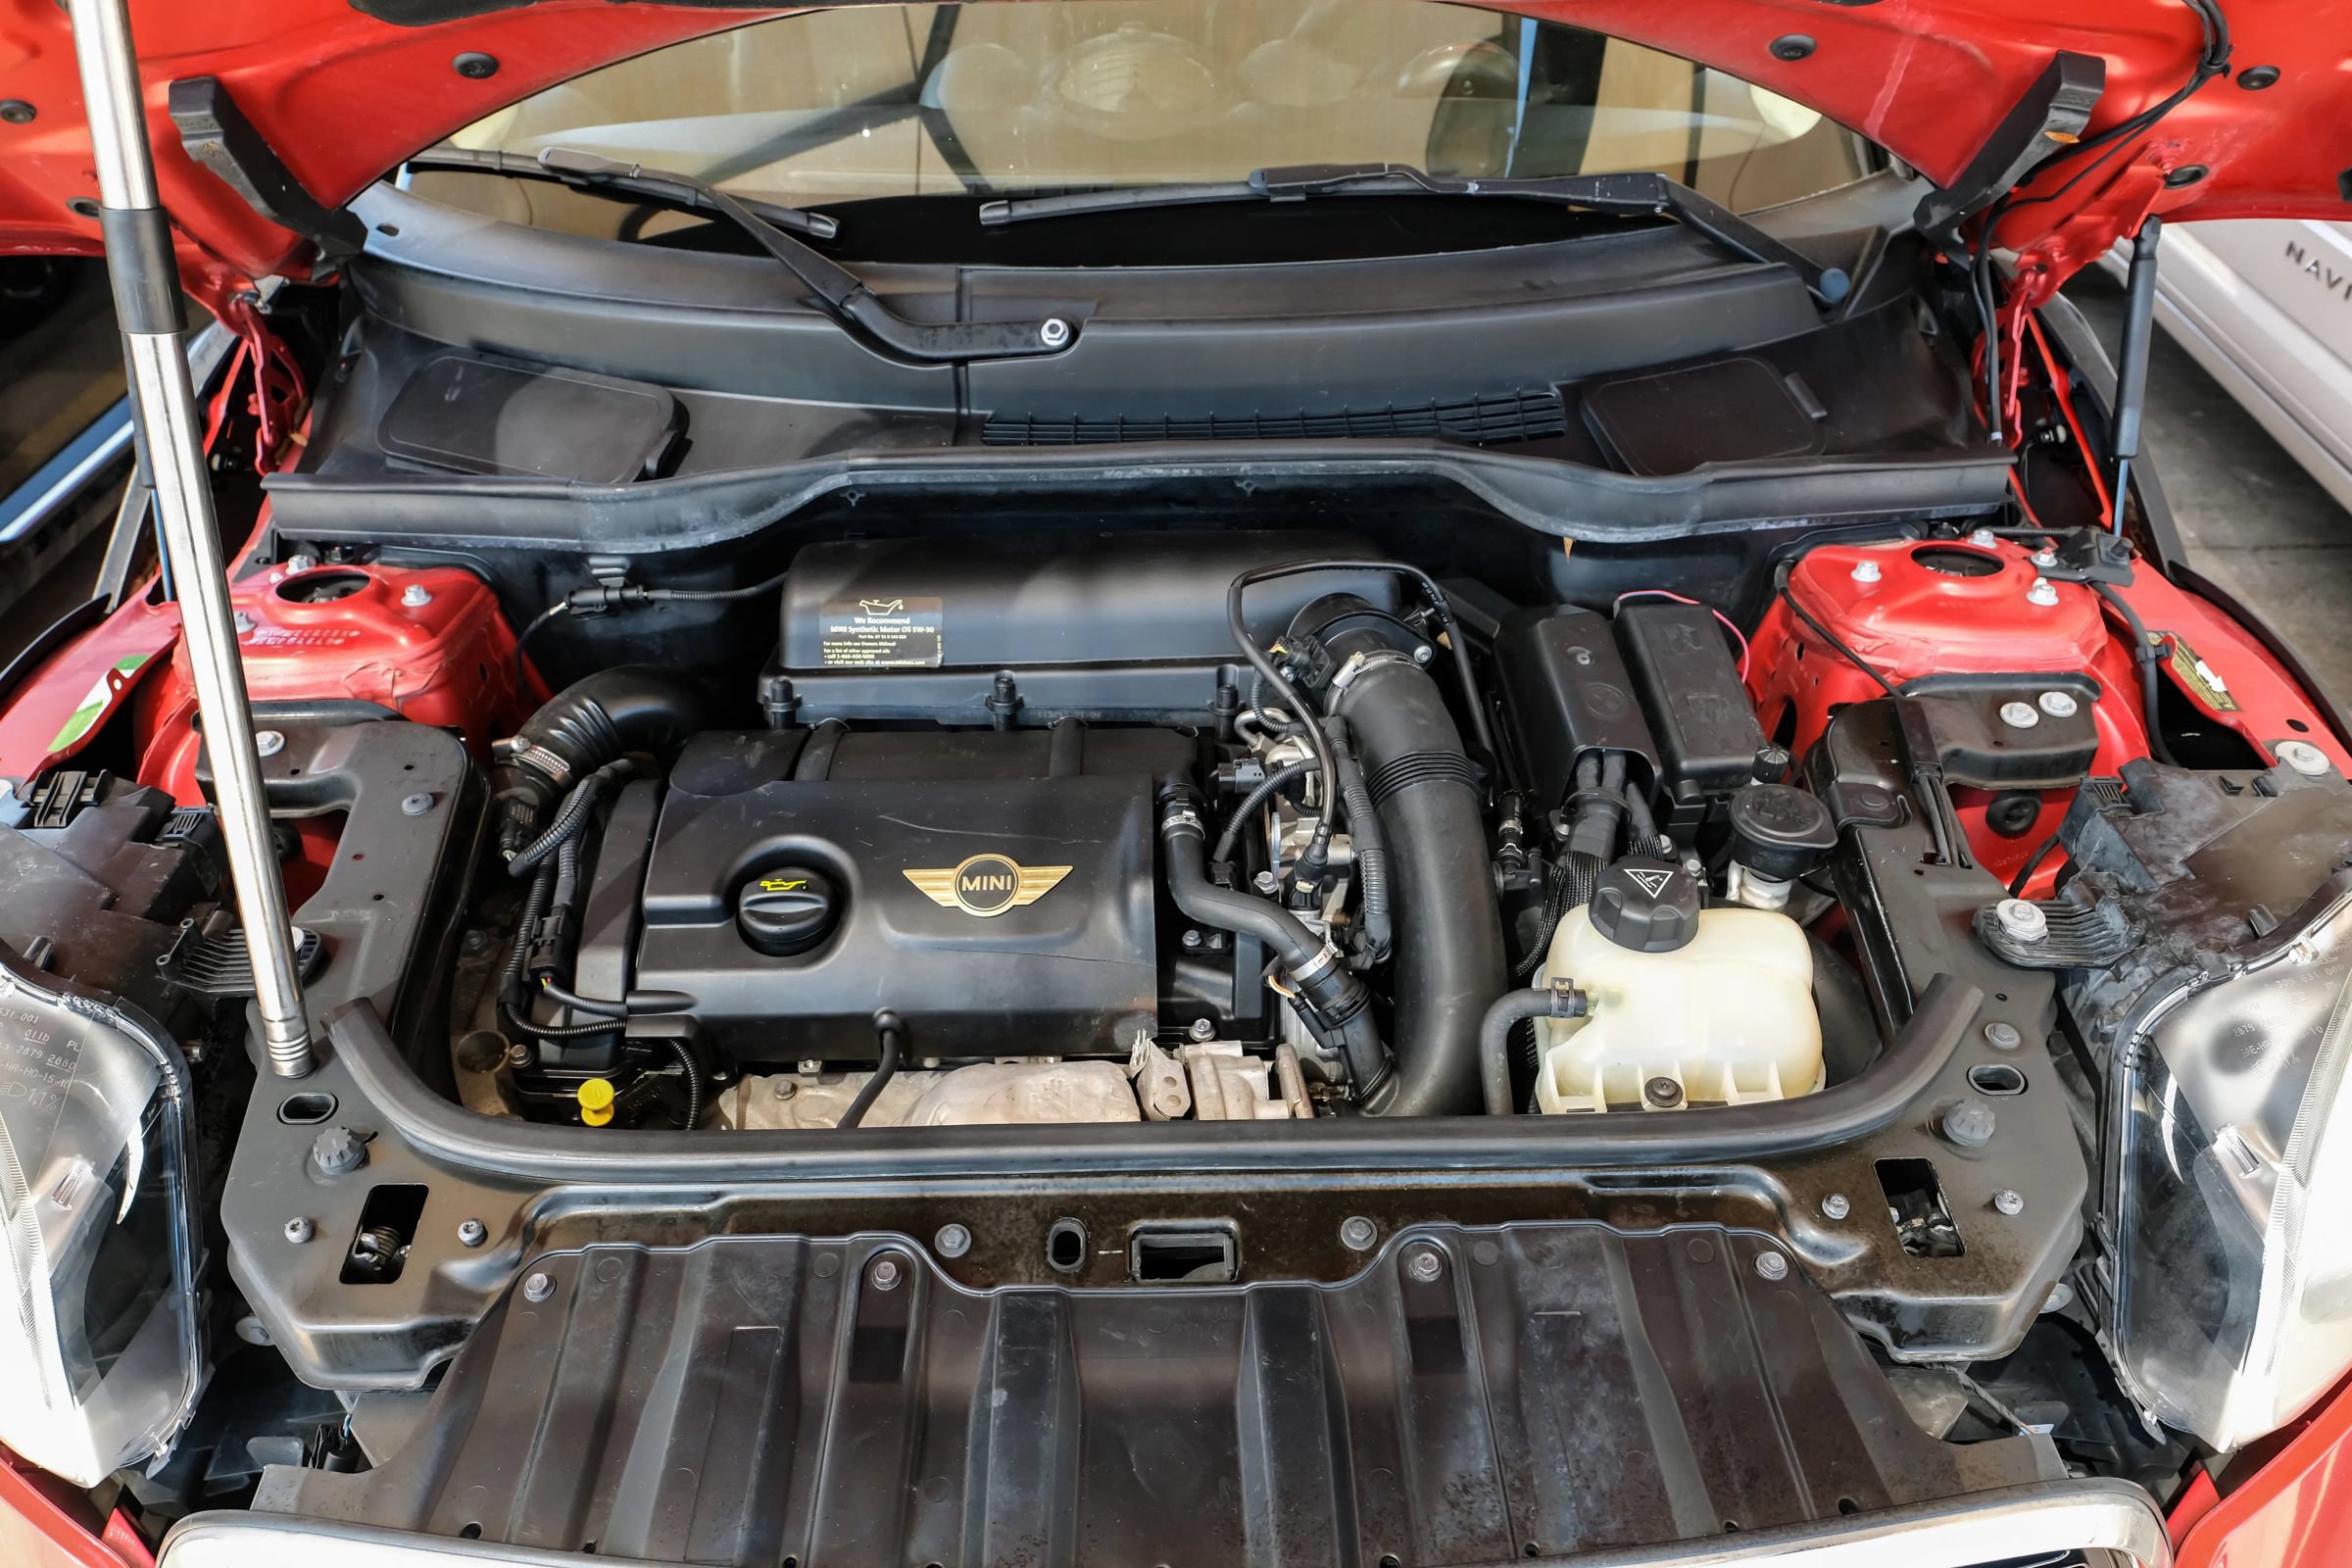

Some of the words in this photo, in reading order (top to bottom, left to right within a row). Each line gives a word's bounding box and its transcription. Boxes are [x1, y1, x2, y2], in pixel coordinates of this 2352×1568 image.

[848, 625, 880, 635] Synthetic
[961, 875, 1012, 892] MINI
[16, 1045, 43, 1058] 2879
[47, 1054, 76, 1070] 2880
